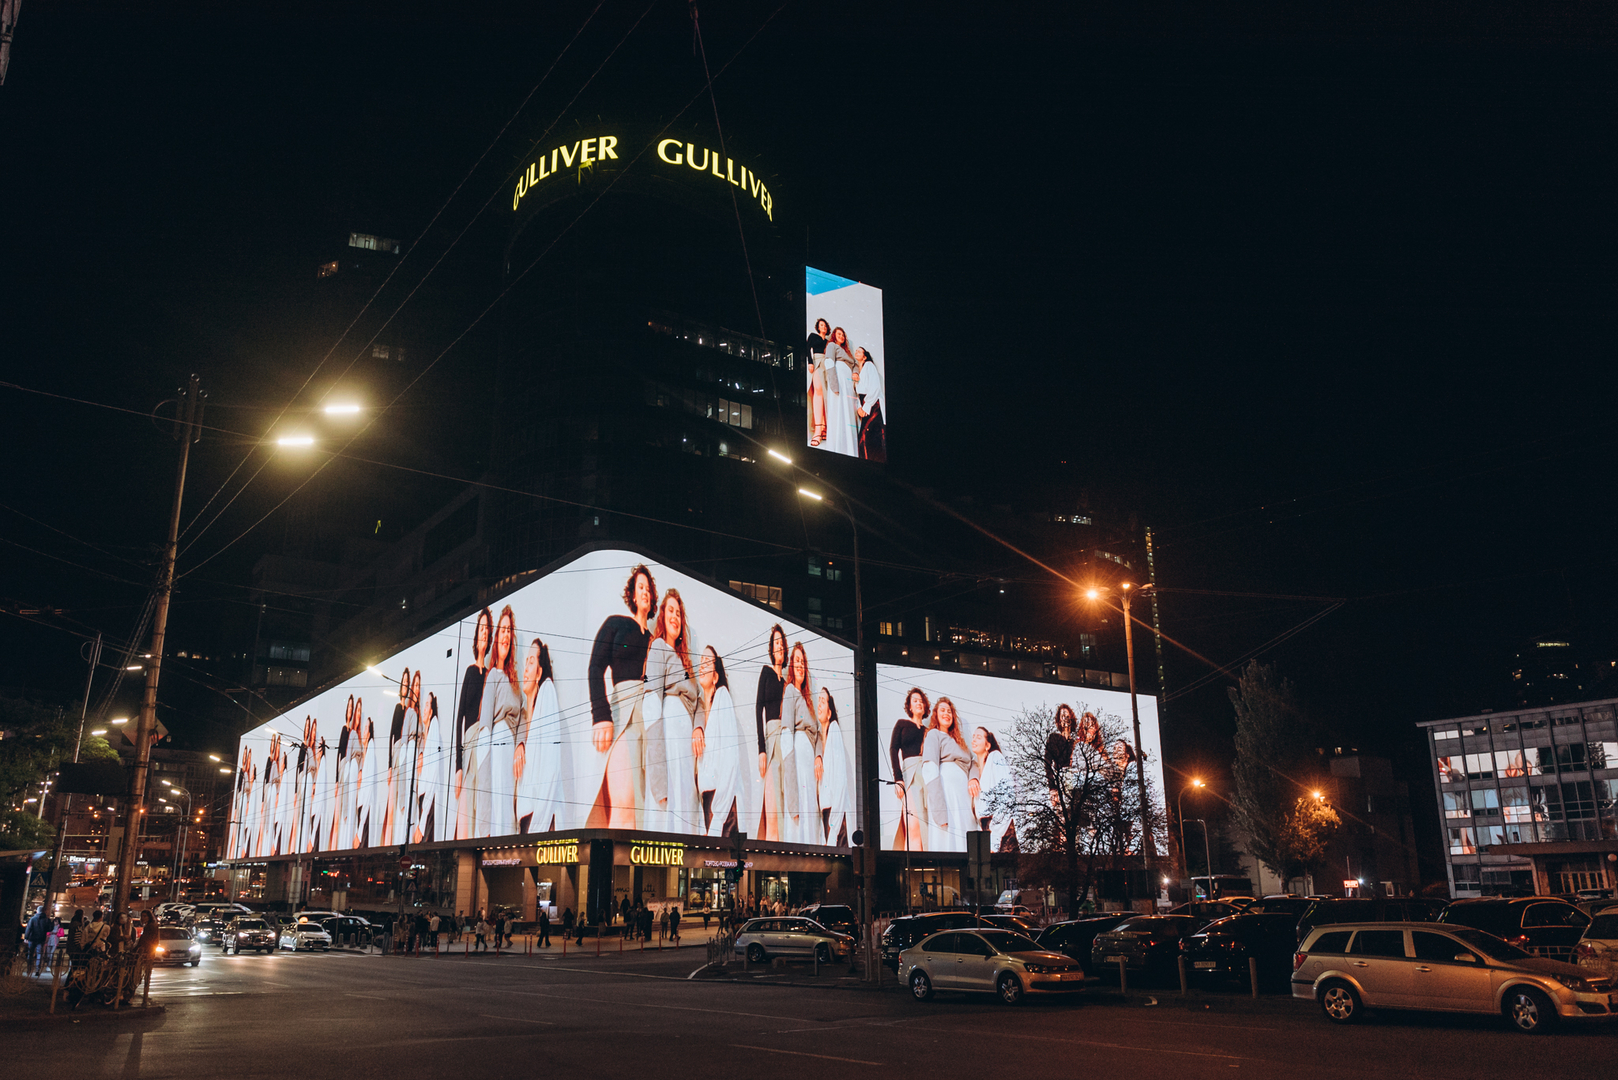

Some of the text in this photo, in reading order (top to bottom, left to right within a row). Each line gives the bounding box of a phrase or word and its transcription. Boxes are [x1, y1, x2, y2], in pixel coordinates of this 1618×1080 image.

[513, 135, 619, 211] GULLIVER
[657, 138, 773, 222] GULLIVER
[536, 845, 579, 864] GULLIVER
[630, 845, 684, 866] GULLIVER
